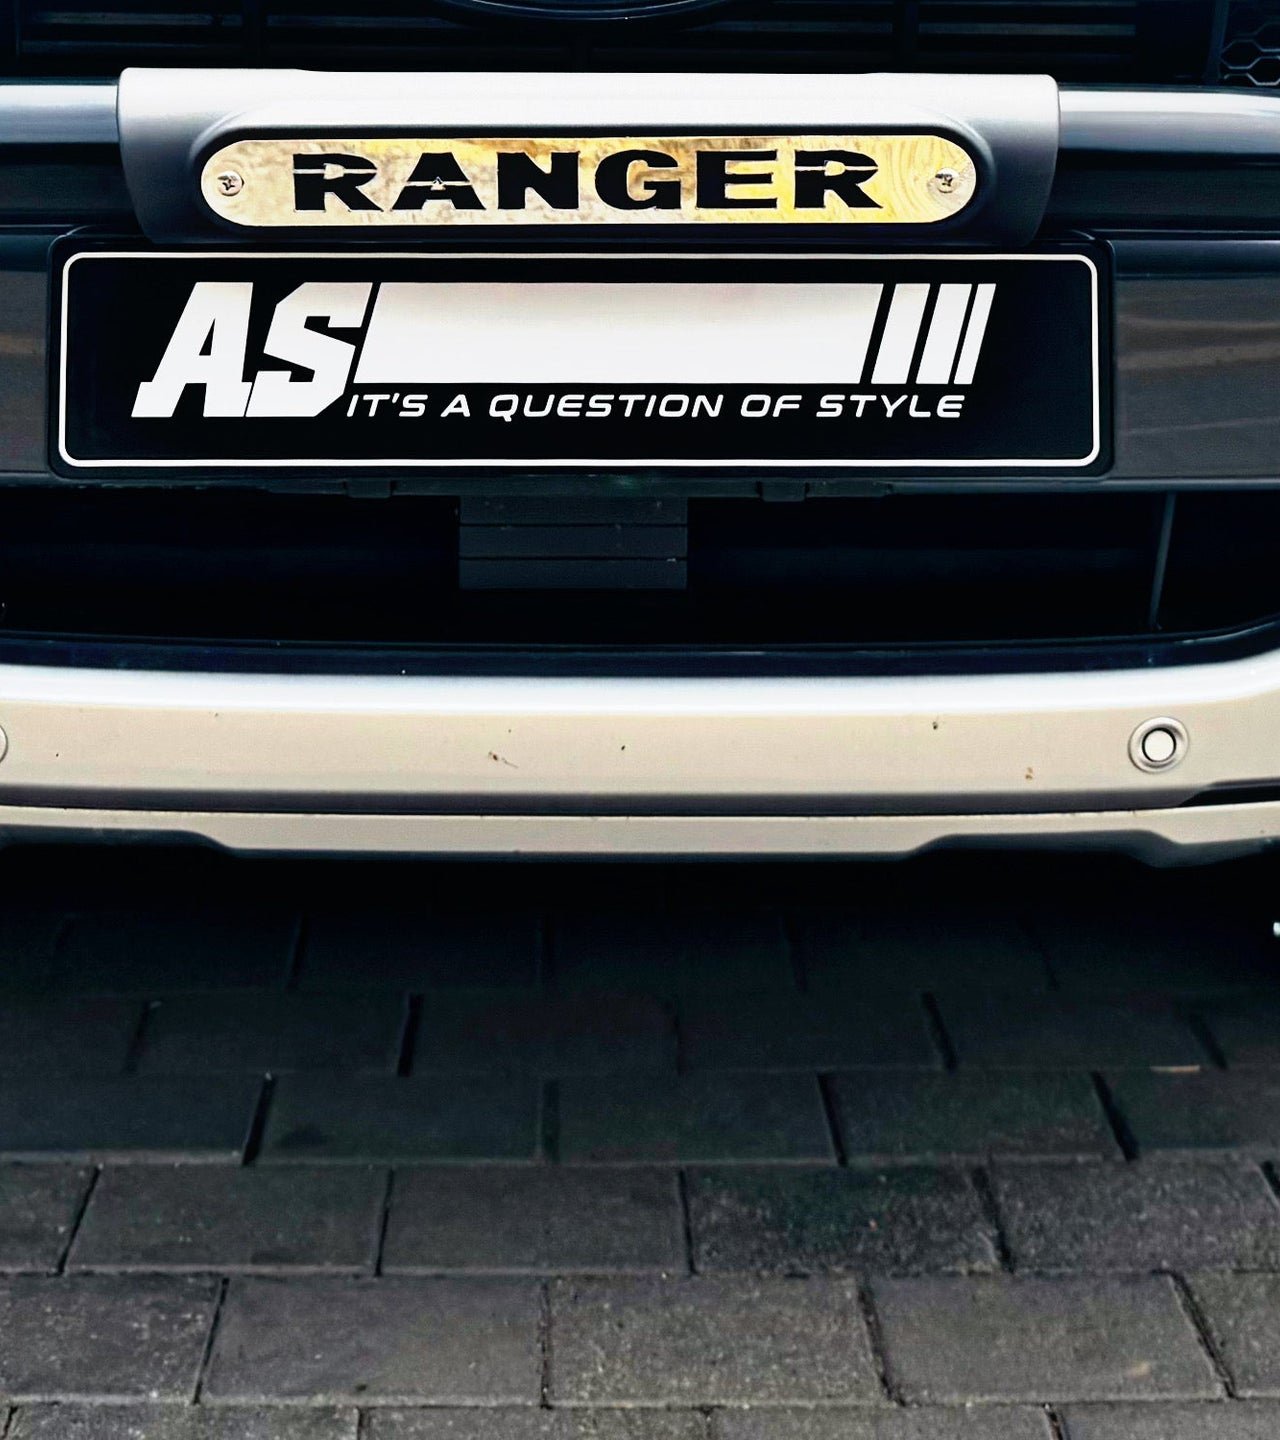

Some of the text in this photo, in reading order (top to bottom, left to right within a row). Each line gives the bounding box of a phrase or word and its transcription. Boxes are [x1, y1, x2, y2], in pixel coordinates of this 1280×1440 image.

[291, 148, 884, 213] RANGER
[130, 281, 374, 418] AS
[346, 392, 966, 422] IT'S A QUESTION OF STYLE
